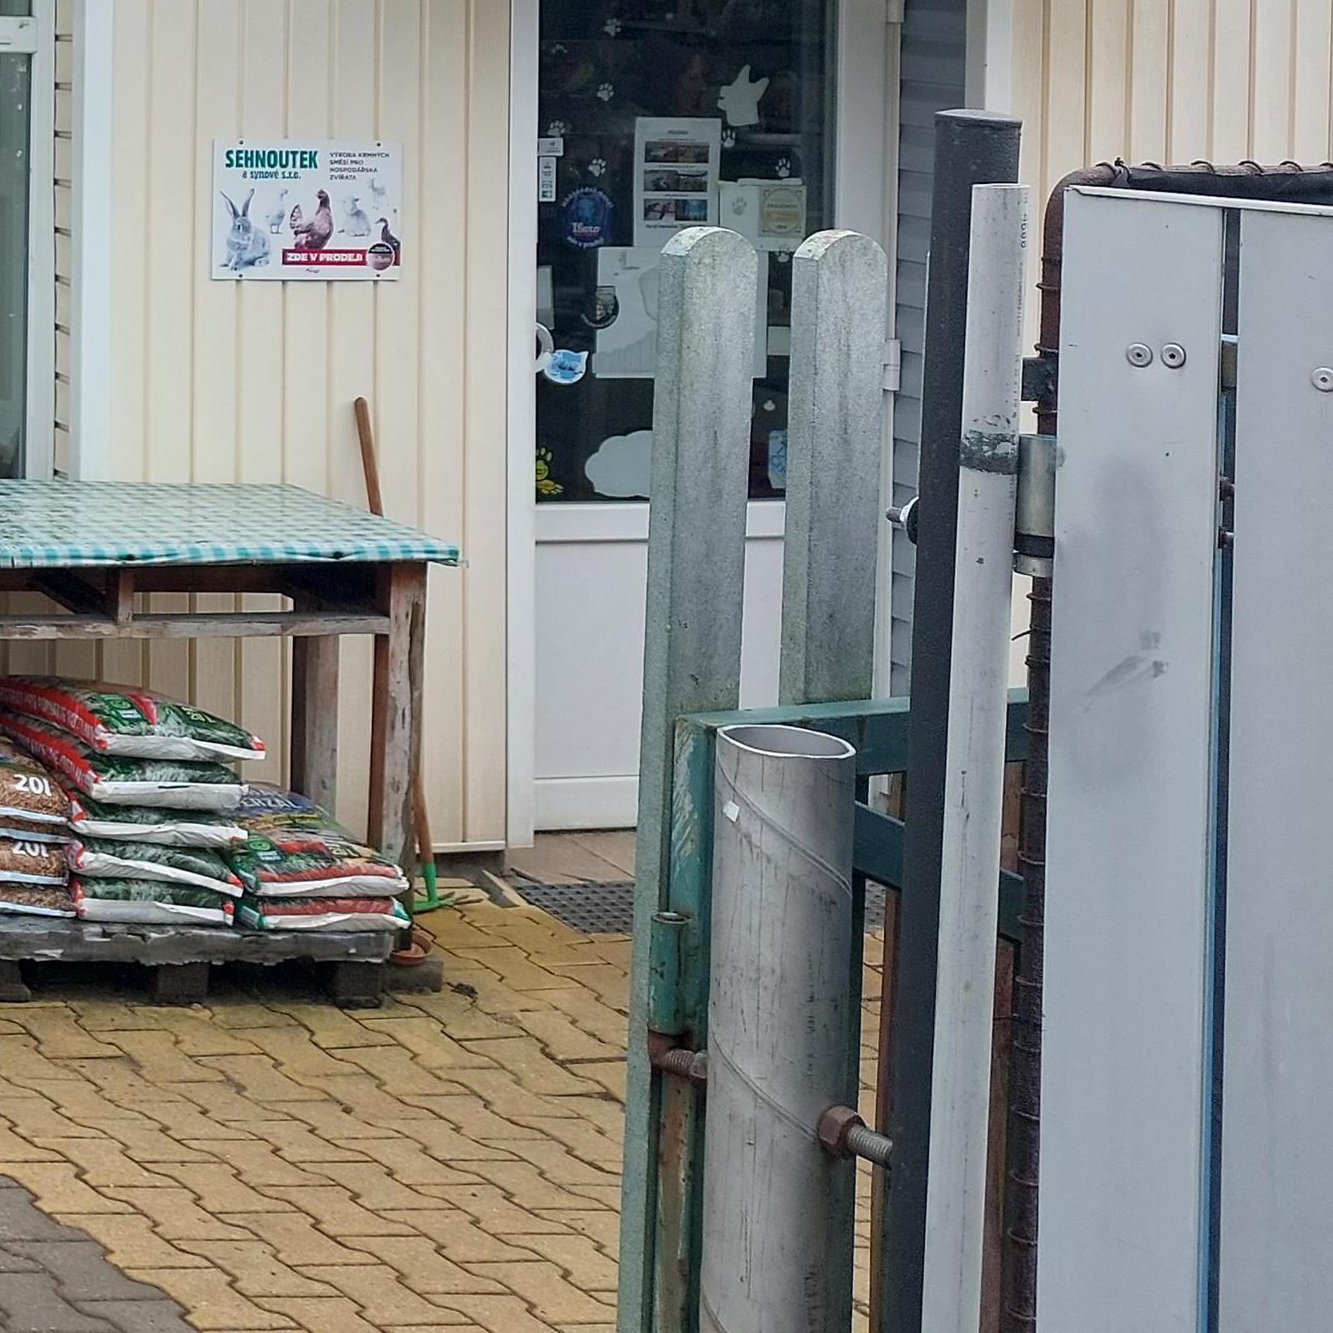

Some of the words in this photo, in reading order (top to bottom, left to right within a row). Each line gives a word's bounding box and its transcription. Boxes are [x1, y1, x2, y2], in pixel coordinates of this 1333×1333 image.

[224, 149, 319, 170] SEHNOUTEK
[242, 171, 248, 179] a
[249, 170, 279, 180] synové
[286, 252, 308, 262] ZDE
[309, 252, 318, 262] V
